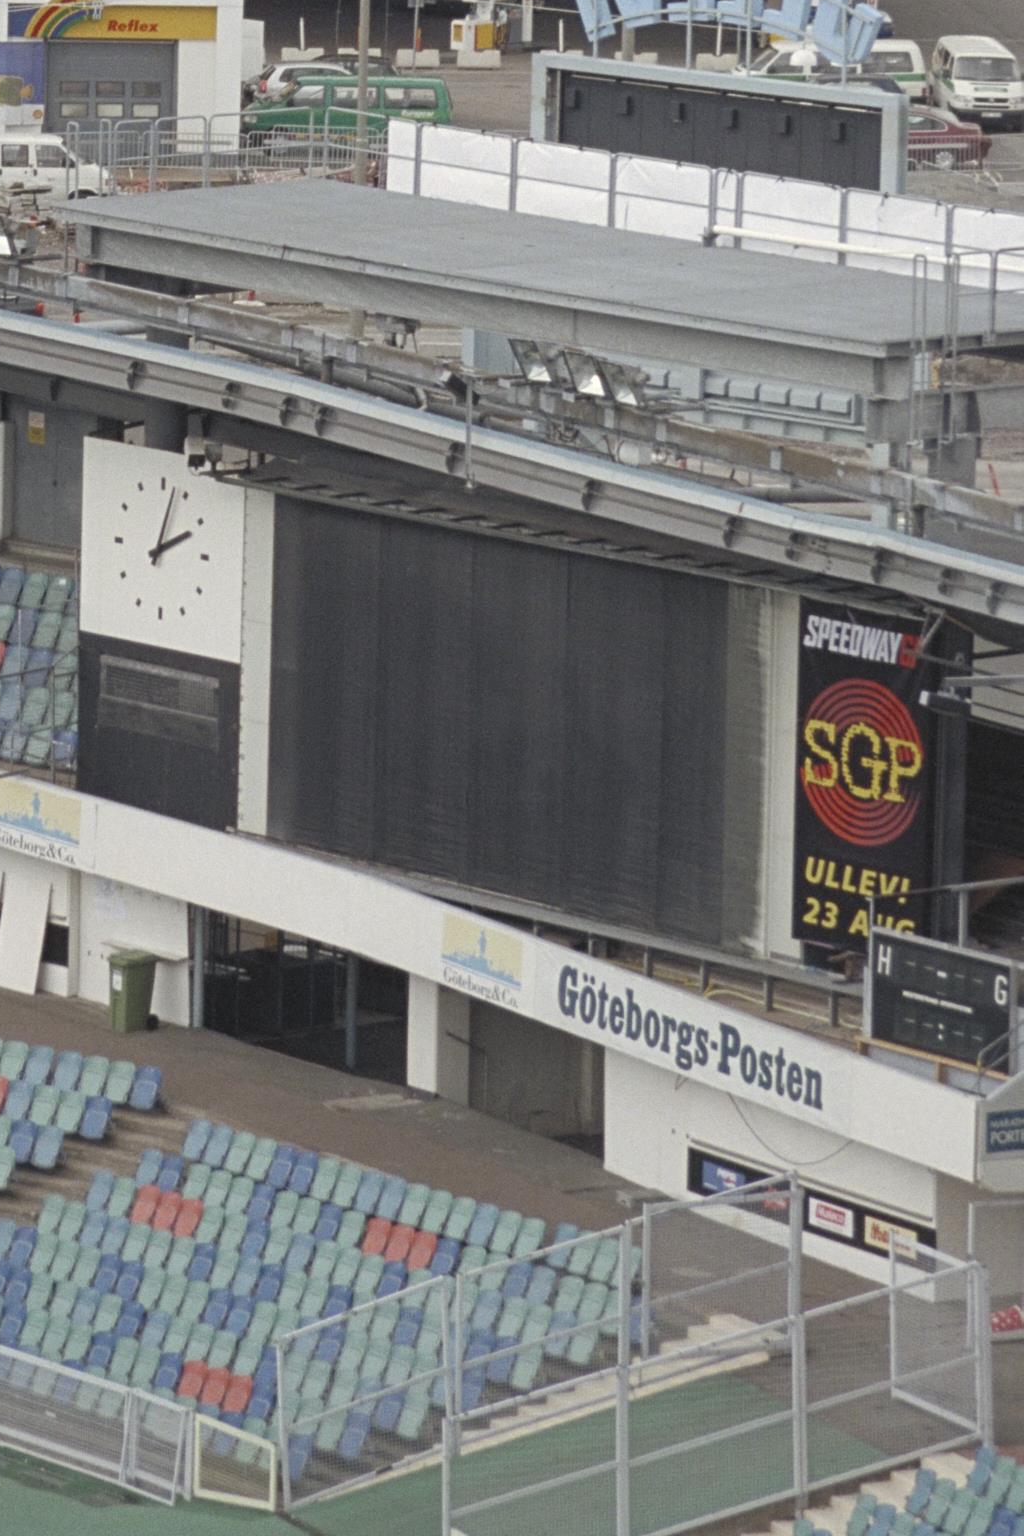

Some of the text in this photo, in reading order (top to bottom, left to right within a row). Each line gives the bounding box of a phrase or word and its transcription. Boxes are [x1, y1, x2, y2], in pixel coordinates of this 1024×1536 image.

[107, 19, 159, 32] Reflex
[803, 614, 902, 665] SPEEDWAY
[804, 720, 922, 803] SGP
[802, 897, 839, 929] 23
[877, 943, 892, 976] H
[993, 974, 1008, 1006] G
[558, 964, 824, 1110] Göteborgs-Posten
